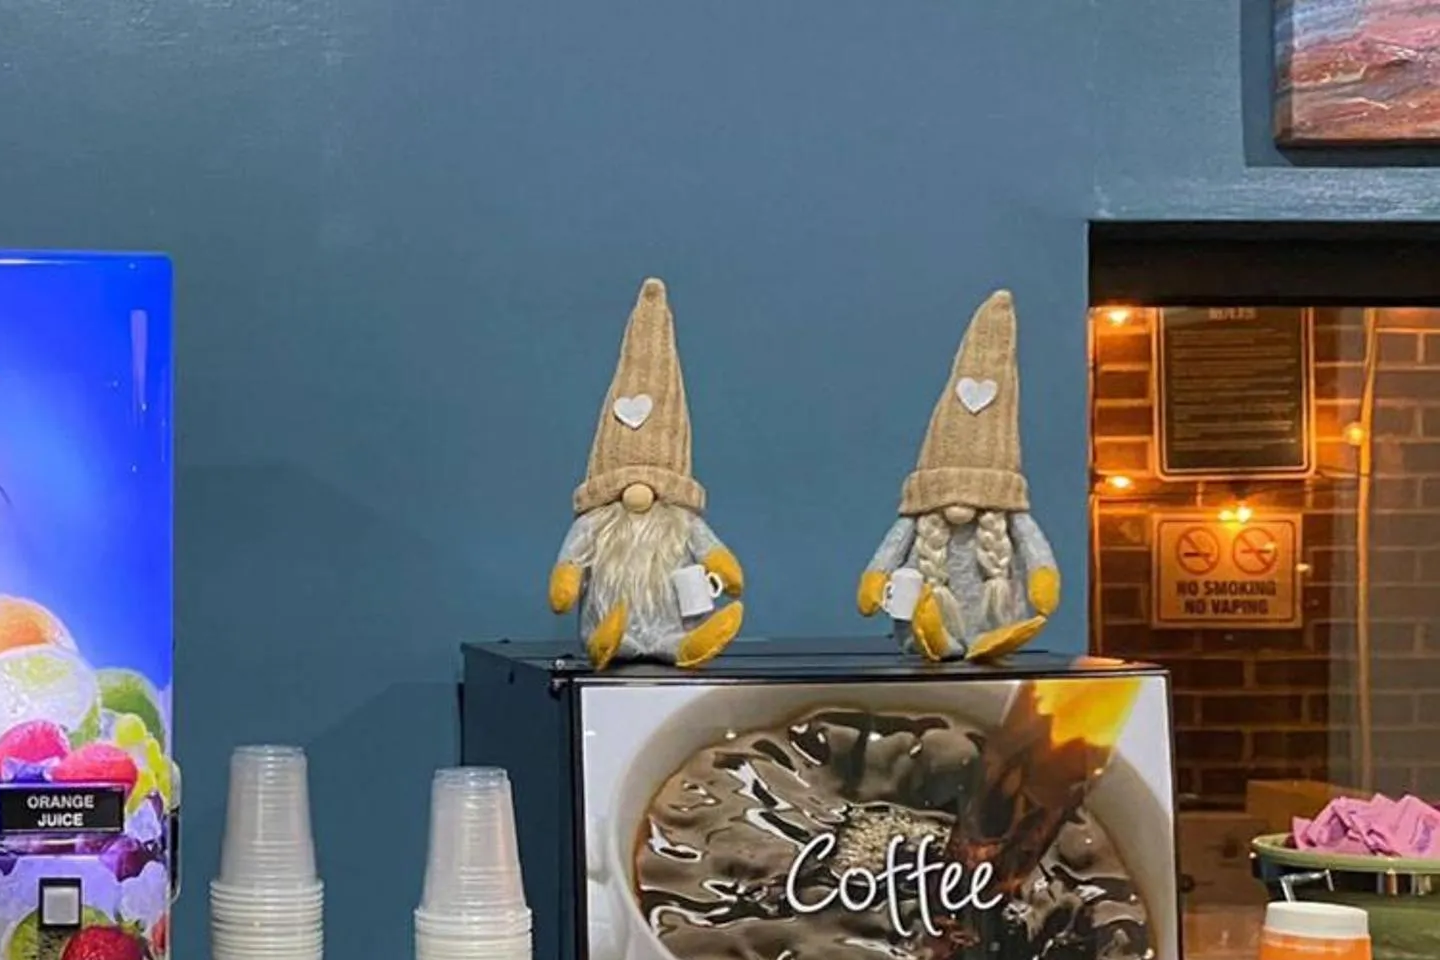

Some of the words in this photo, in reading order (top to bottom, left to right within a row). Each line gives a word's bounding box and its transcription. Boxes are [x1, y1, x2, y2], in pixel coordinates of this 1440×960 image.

[1176, 580, 1199, 596] NO
[1203, 580, 1277, 596] SMOKING
[1184, 599, 1206, 615] NO
[26, 793, 95, 812] ORANGE
[37, 812, 84, 828] JUICE
[786, 833, 1006, 936] Coffee
